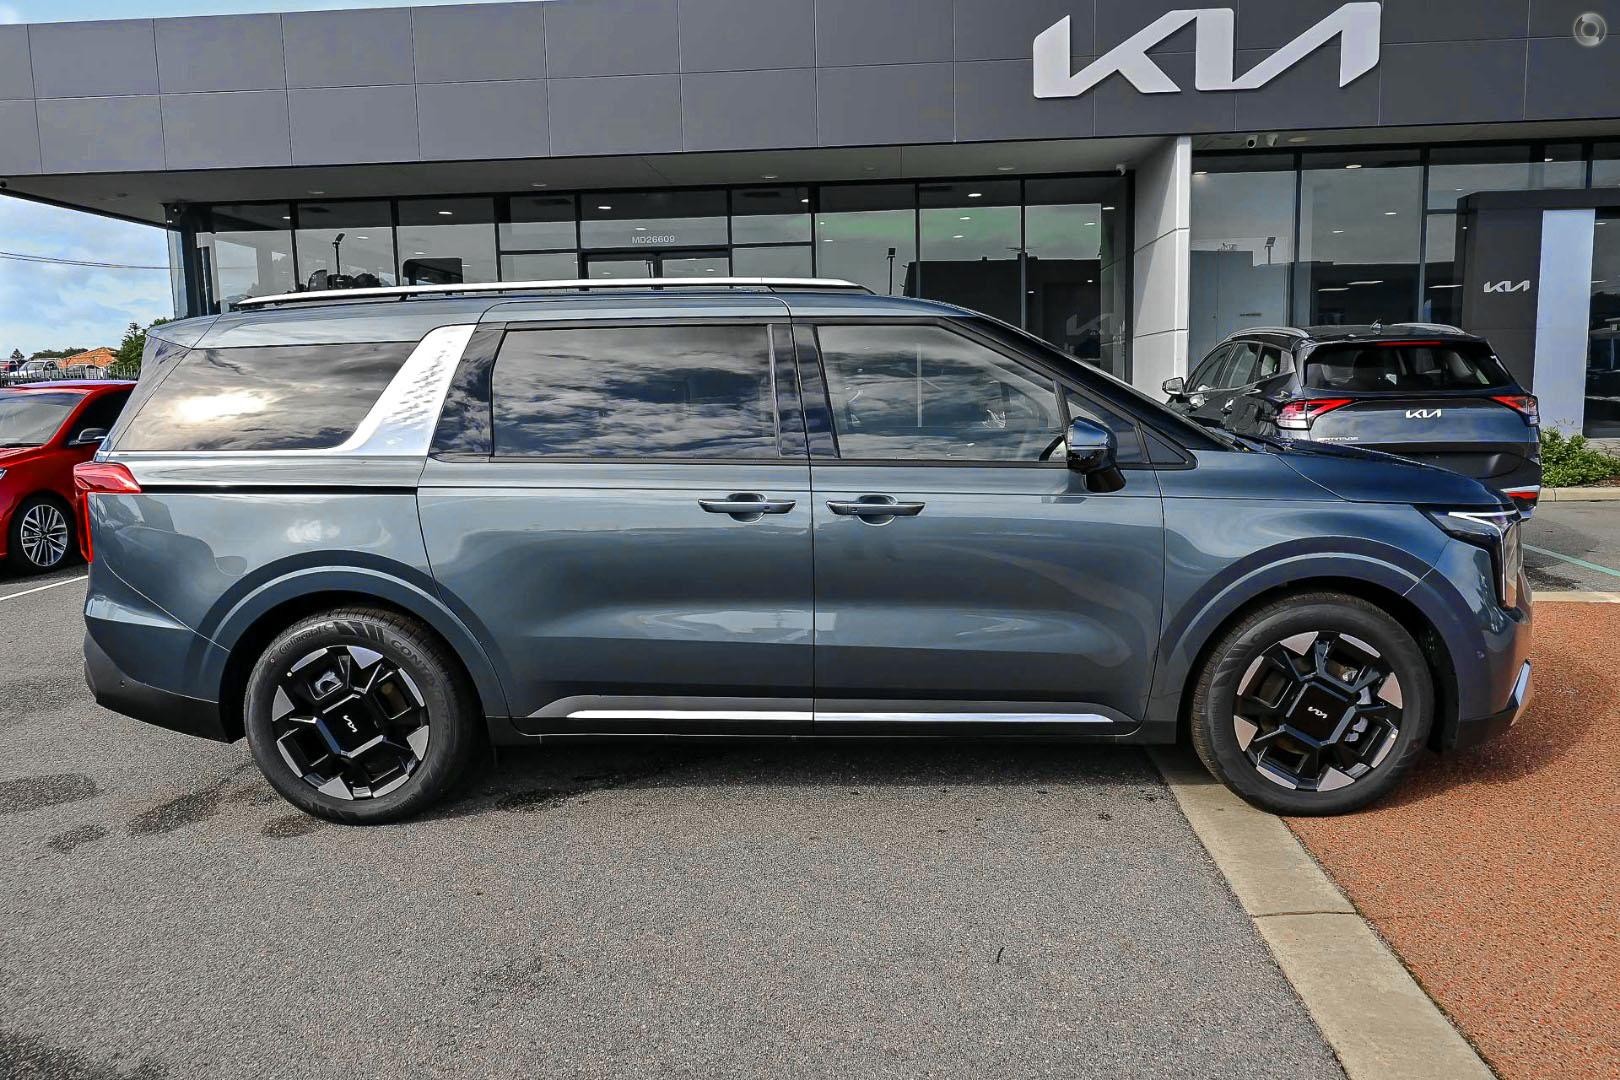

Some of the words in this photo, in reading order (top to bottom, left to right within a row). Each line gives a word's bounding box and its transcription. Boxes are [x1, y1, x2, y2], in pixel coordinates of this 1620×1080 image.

[1033, 2, 1382, 99] KIA
[631, 235, 676, 244] MD26609
[1483, 280, 1530, 293] KIA
[1405, 409, 1442, 419] KIA
